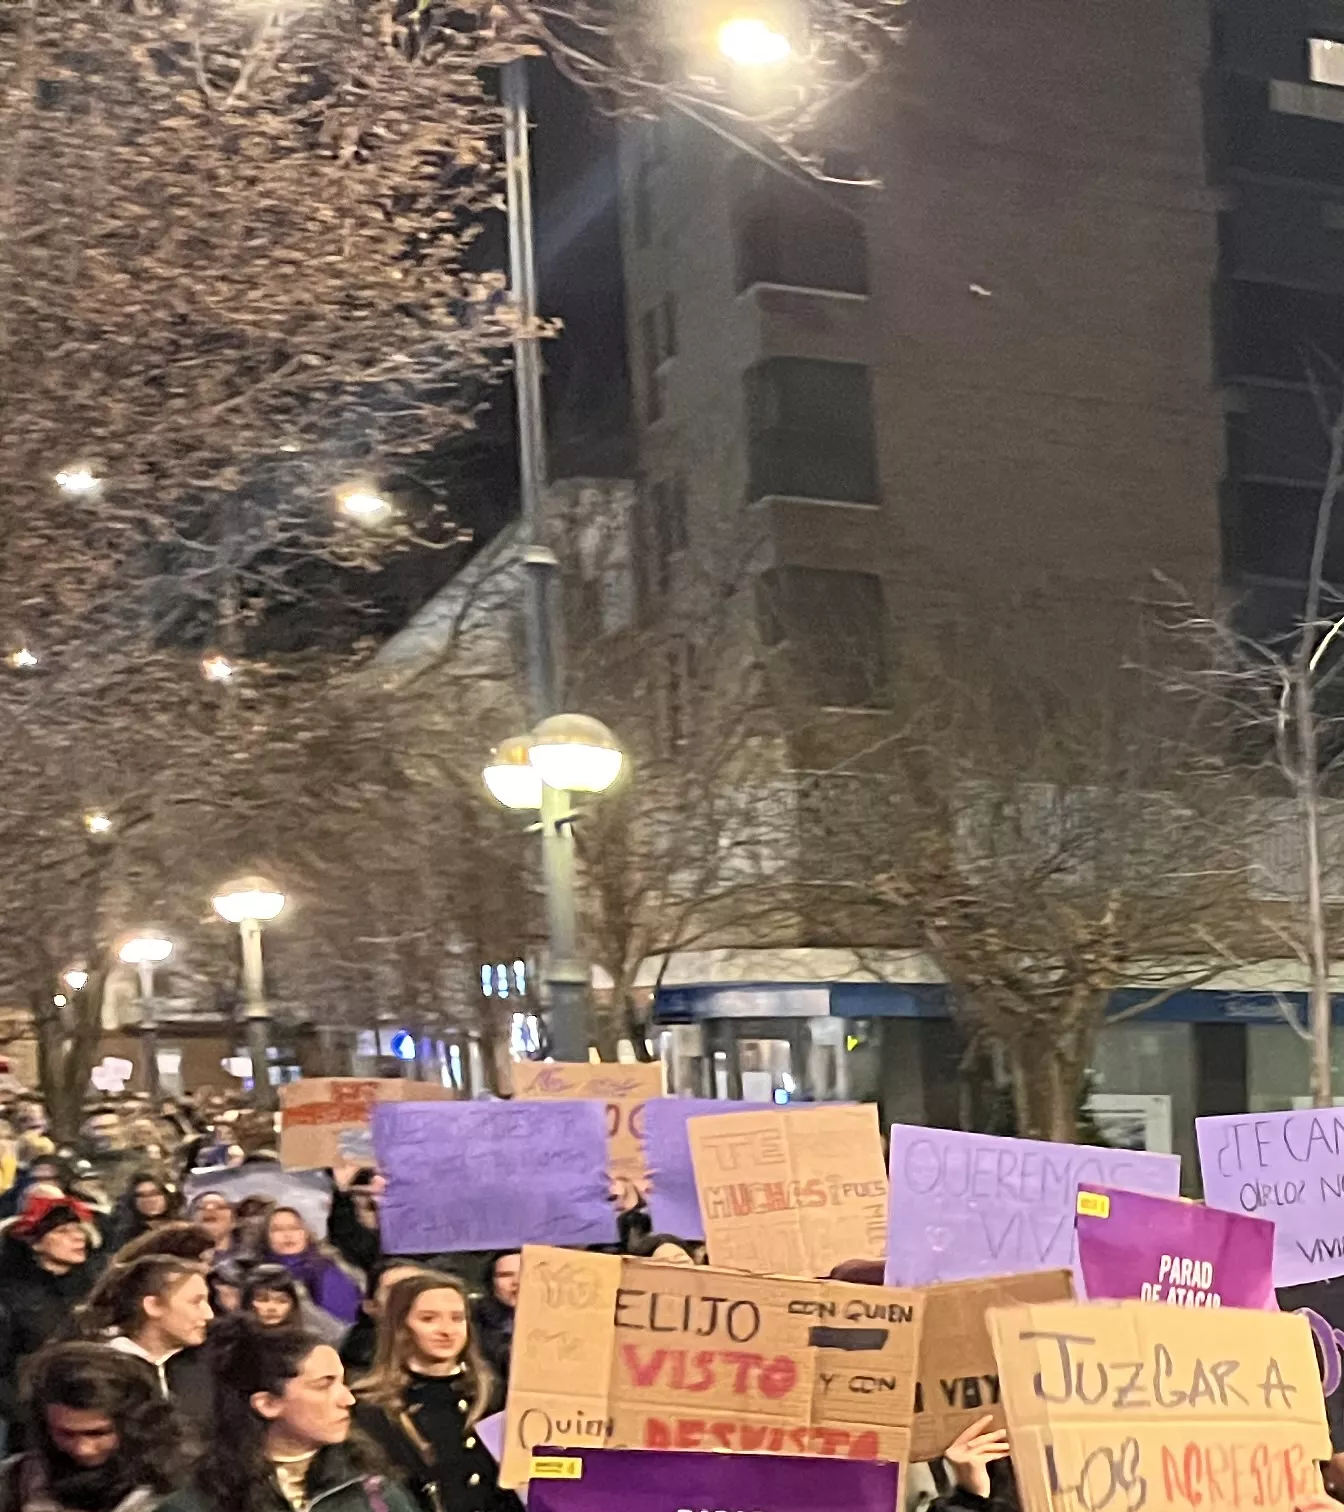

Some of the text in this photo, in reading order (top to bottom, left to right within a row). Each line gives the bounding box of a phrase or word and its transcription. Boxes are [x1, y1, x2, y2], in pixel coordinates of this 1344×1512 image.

[1159, 1254, 1214, 1291] PARAD
[613, 1289, 762, 1344] ELIJO
[619, 1342, 800, 1400] VISTO
[1256, 1357, 1297, 1409] A
